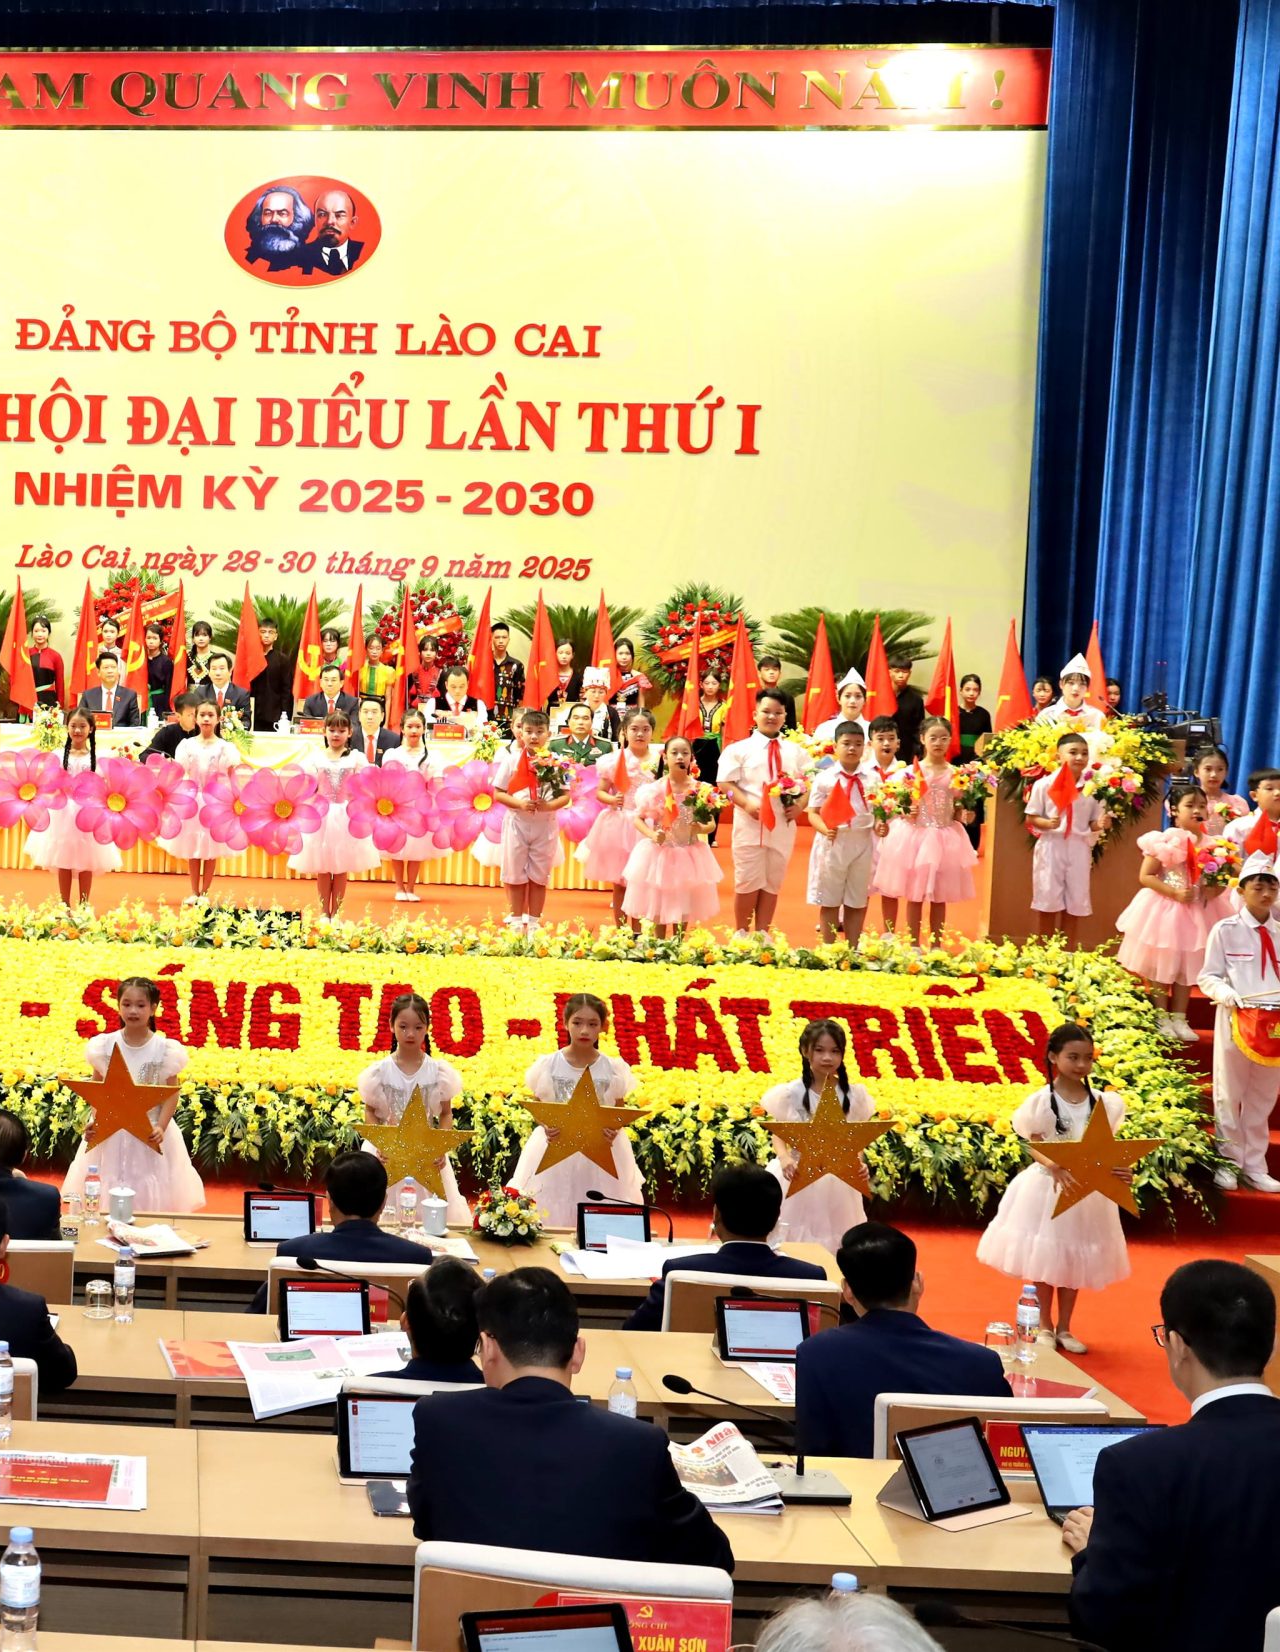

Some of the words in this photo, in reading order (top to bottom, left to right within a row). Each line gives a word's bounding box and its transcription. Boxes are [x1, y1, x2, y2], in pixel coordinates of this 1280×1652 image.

[110, 70, 351, 117] QUANG
[372, 71, 547, 110] VINH
[566, 58, 781, 111] MUÔN
[15, 304, 155, 353] ĐẢNG
[168, 309, 238, 361] BỘ
[249, 306, 378, 356] TỈNH
[395, 313, 497, 357] LÀO
[514, 322, 603, 359] CAI
[127, 395, 238, 457] ĐẠI
[255, 371, 412, 450] BIỂU
[426, 371, 562, 453] LẦN
[577, 384, 727, 456] THỨ
[735, 403, 764, 456] I
[14, 464, 183, 519] NHIỆM
[203, 465, 280, 511] KỲ
[299, 479, 425, 514] 2025
[462, 481, 595, 518] 2030
[15, 543, 74, 568] Lào
[141, 545, 219, 577] ngày
[325, 551, 416, 582] tháng
[420, 555, 439, 578] 9
[444, 553, 512, 579] năm
[519, 555, 593, 582] 2025
[75, 963, 301, 1051] SÁNG
[638, 1633, 675, 1652] XUÂN
[678, 1636, 707, 1652] SƠN
